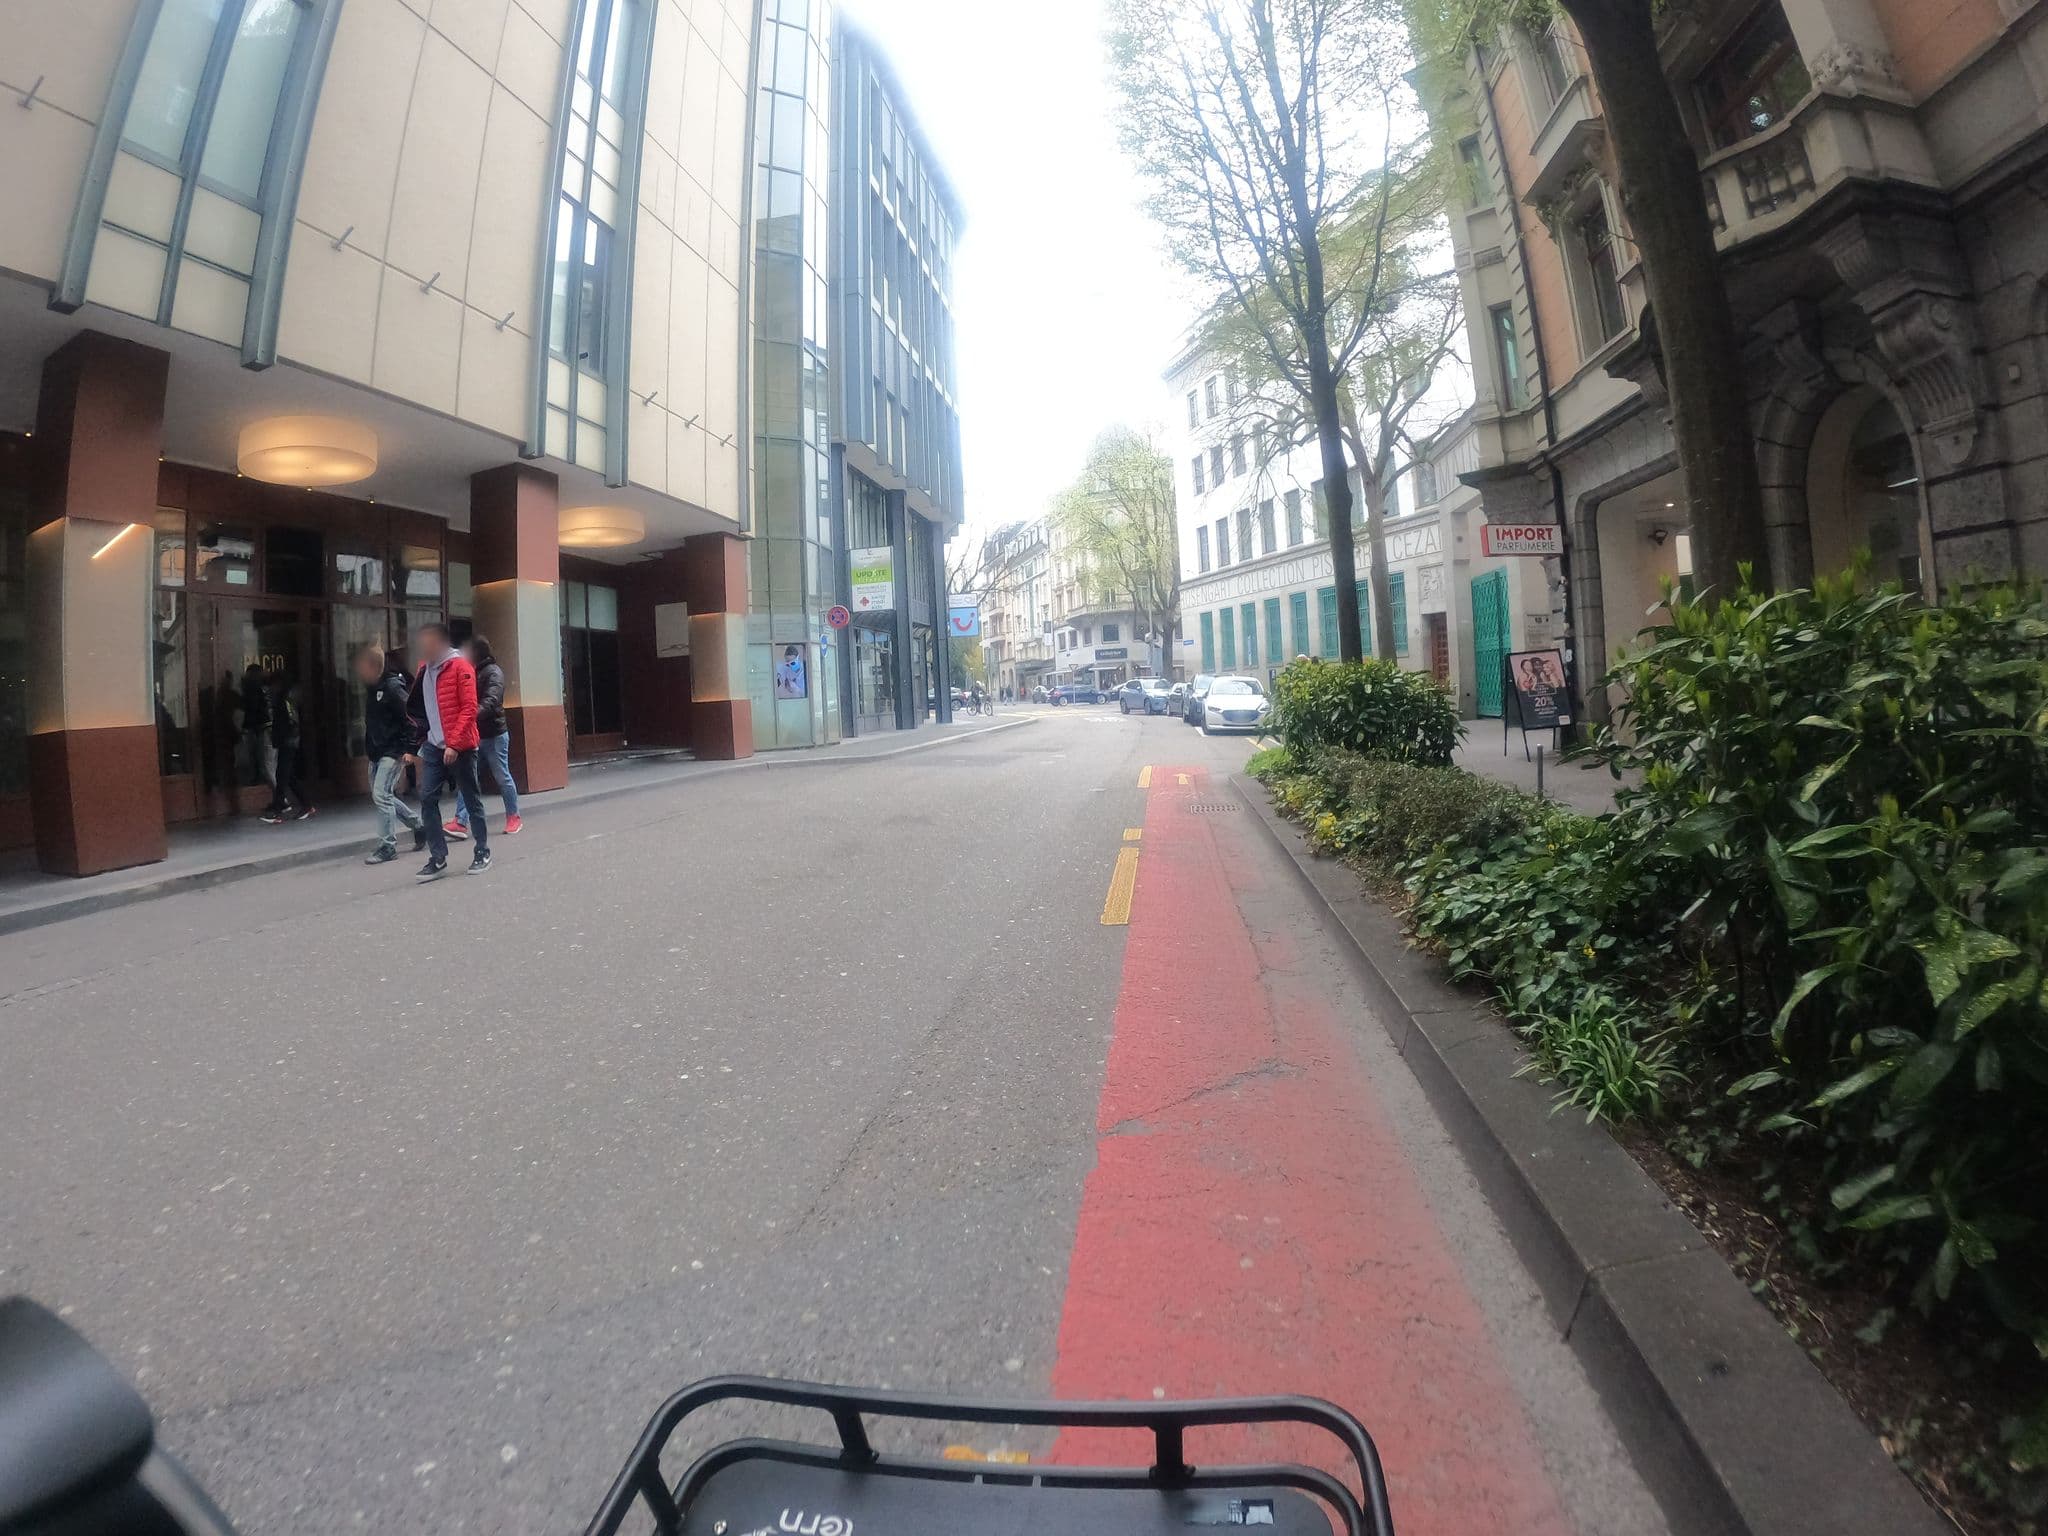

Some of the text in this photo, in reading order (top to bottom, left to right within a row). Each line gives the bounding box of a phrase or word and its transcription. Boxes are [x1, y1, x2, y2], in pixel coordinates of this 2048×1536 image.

[1496, 528, 1553, 541] IMPORT
[1497, 541, 1555, 551] PARFUMERIE
[1238, 561, 1304, 595] COLLECTION
[1393, 525, 1442, 559] CEZA
